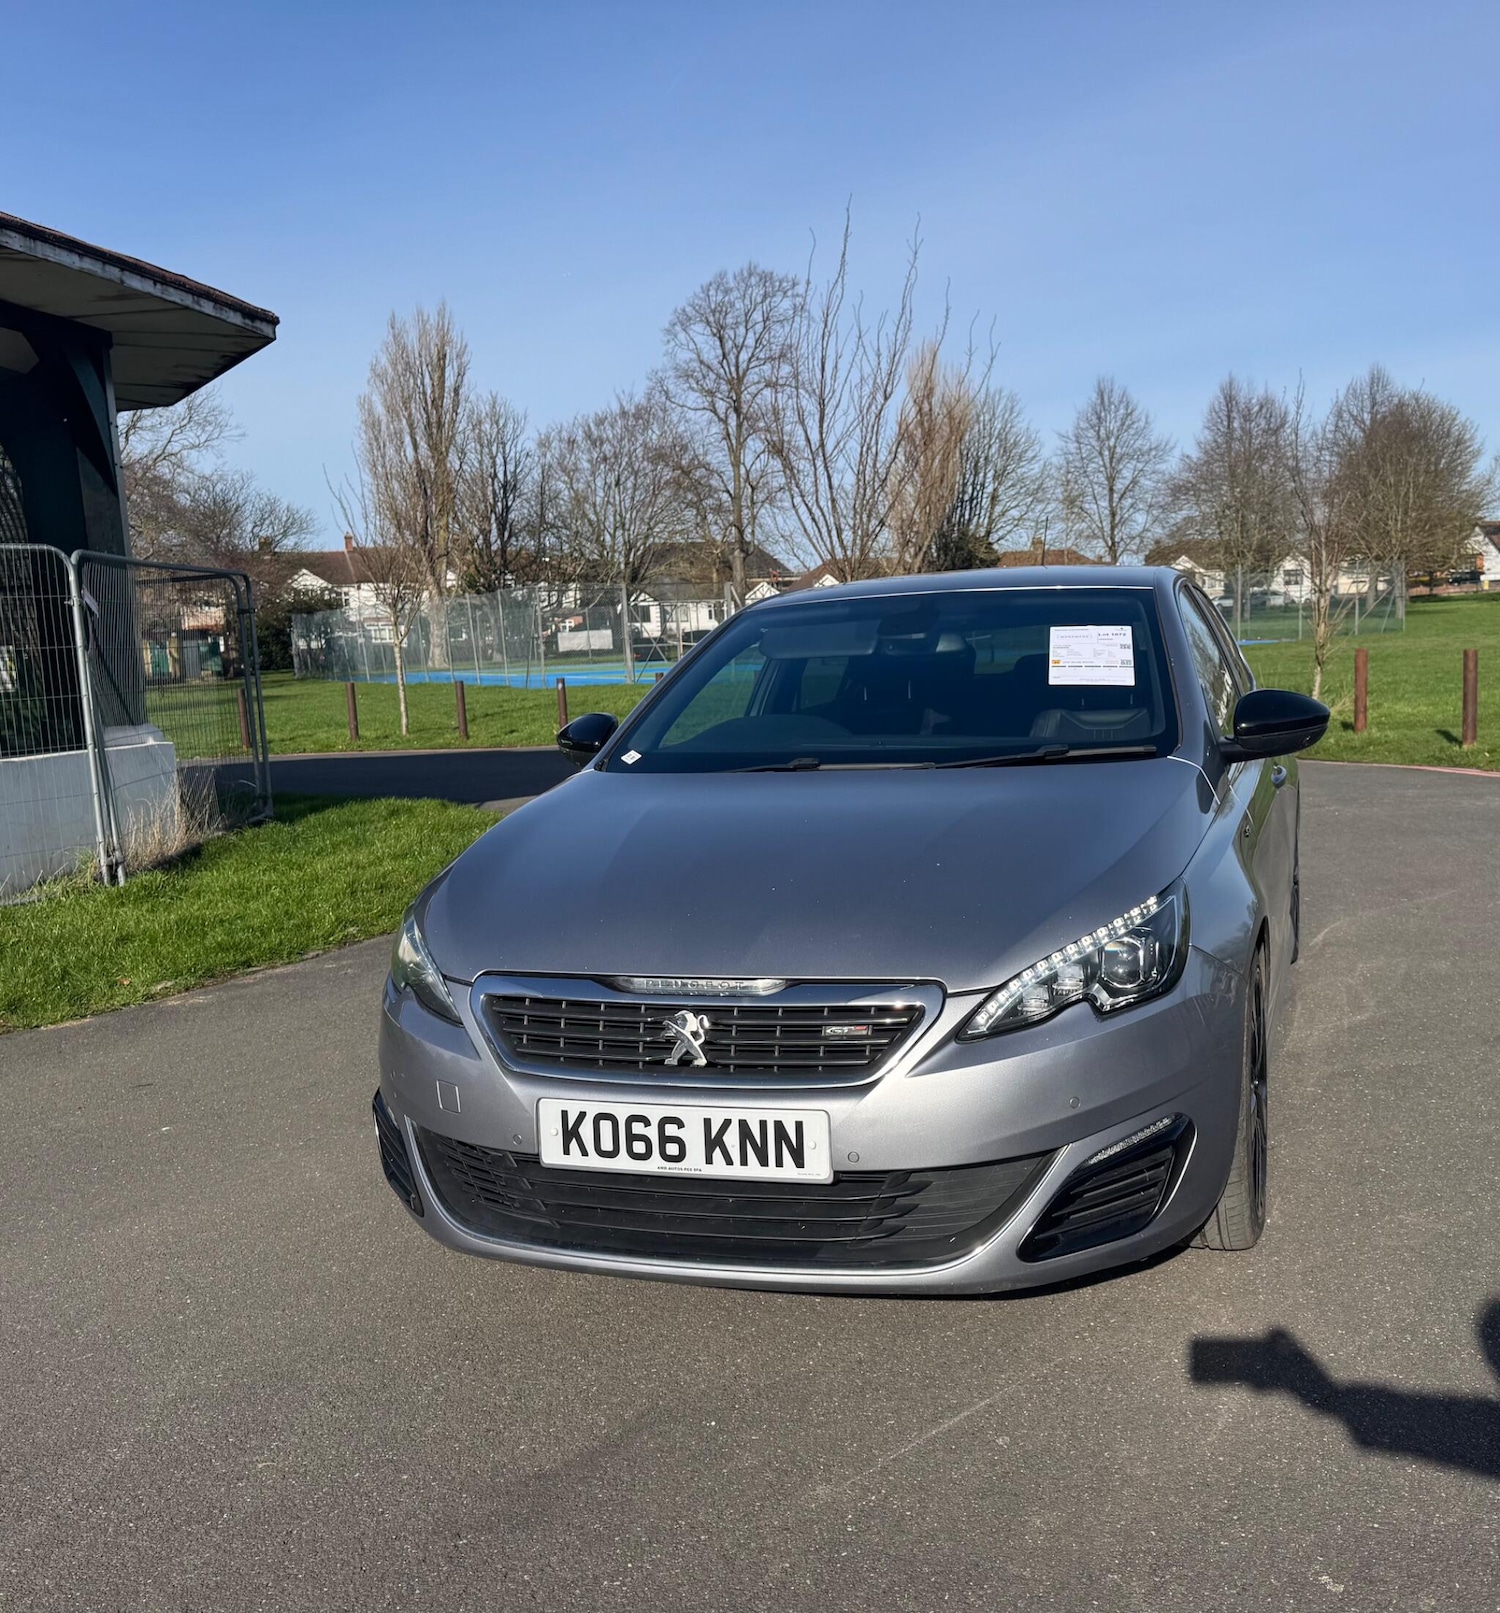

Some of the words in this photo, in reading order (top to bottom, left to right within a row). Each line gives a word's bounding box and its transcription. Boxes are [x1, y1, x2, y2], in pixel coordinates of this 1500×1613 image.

[644, 979, 745, 990] PEUGEOT
[560, 1109, 687, 1163] KO66
[703, 1117, 806, 1169] KNN
